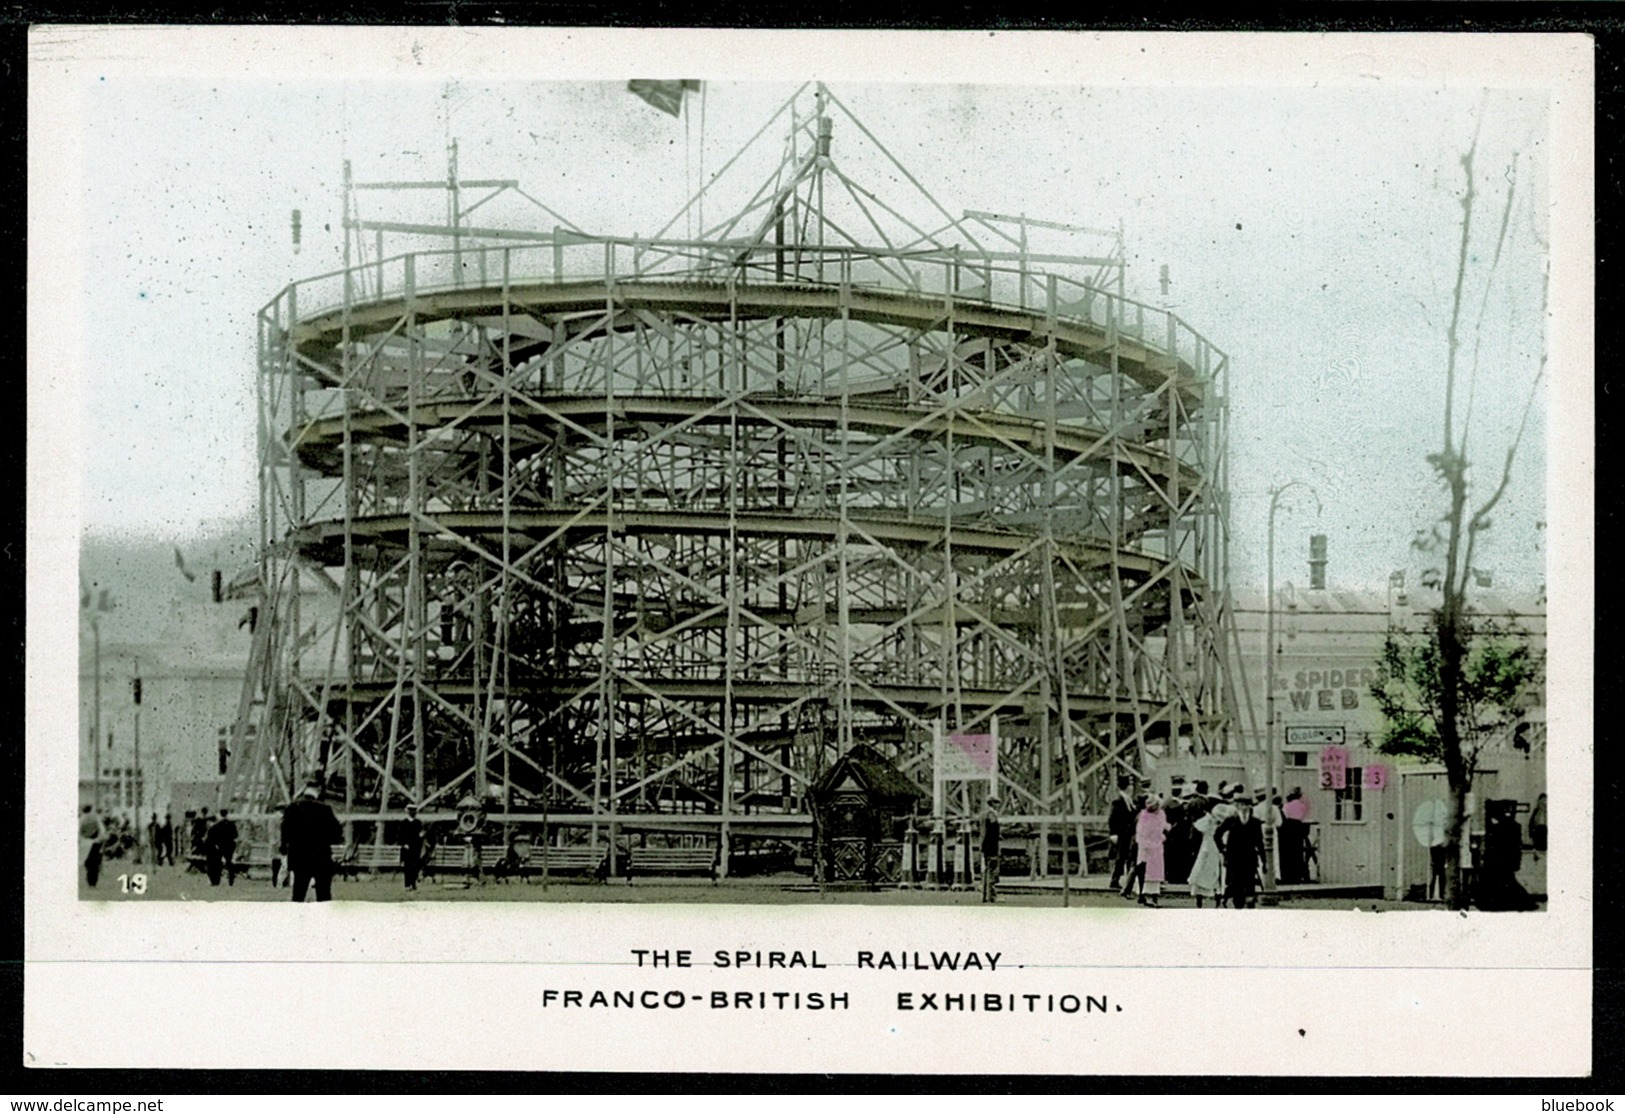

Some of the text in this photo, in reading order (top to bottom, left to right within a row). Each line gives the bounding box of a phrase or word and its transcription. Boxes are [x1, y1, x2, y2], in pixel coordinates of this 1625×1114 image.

[1289, 689, 1359, 712] WEB
[1321, 771, 1333, 787] 3
[631, 949, 692, 968] THE
[713, 949, 827, 969] SPIRAL
[543, 989, 1123, 1014] FRANCO-BRITISH EXHIBITION.
